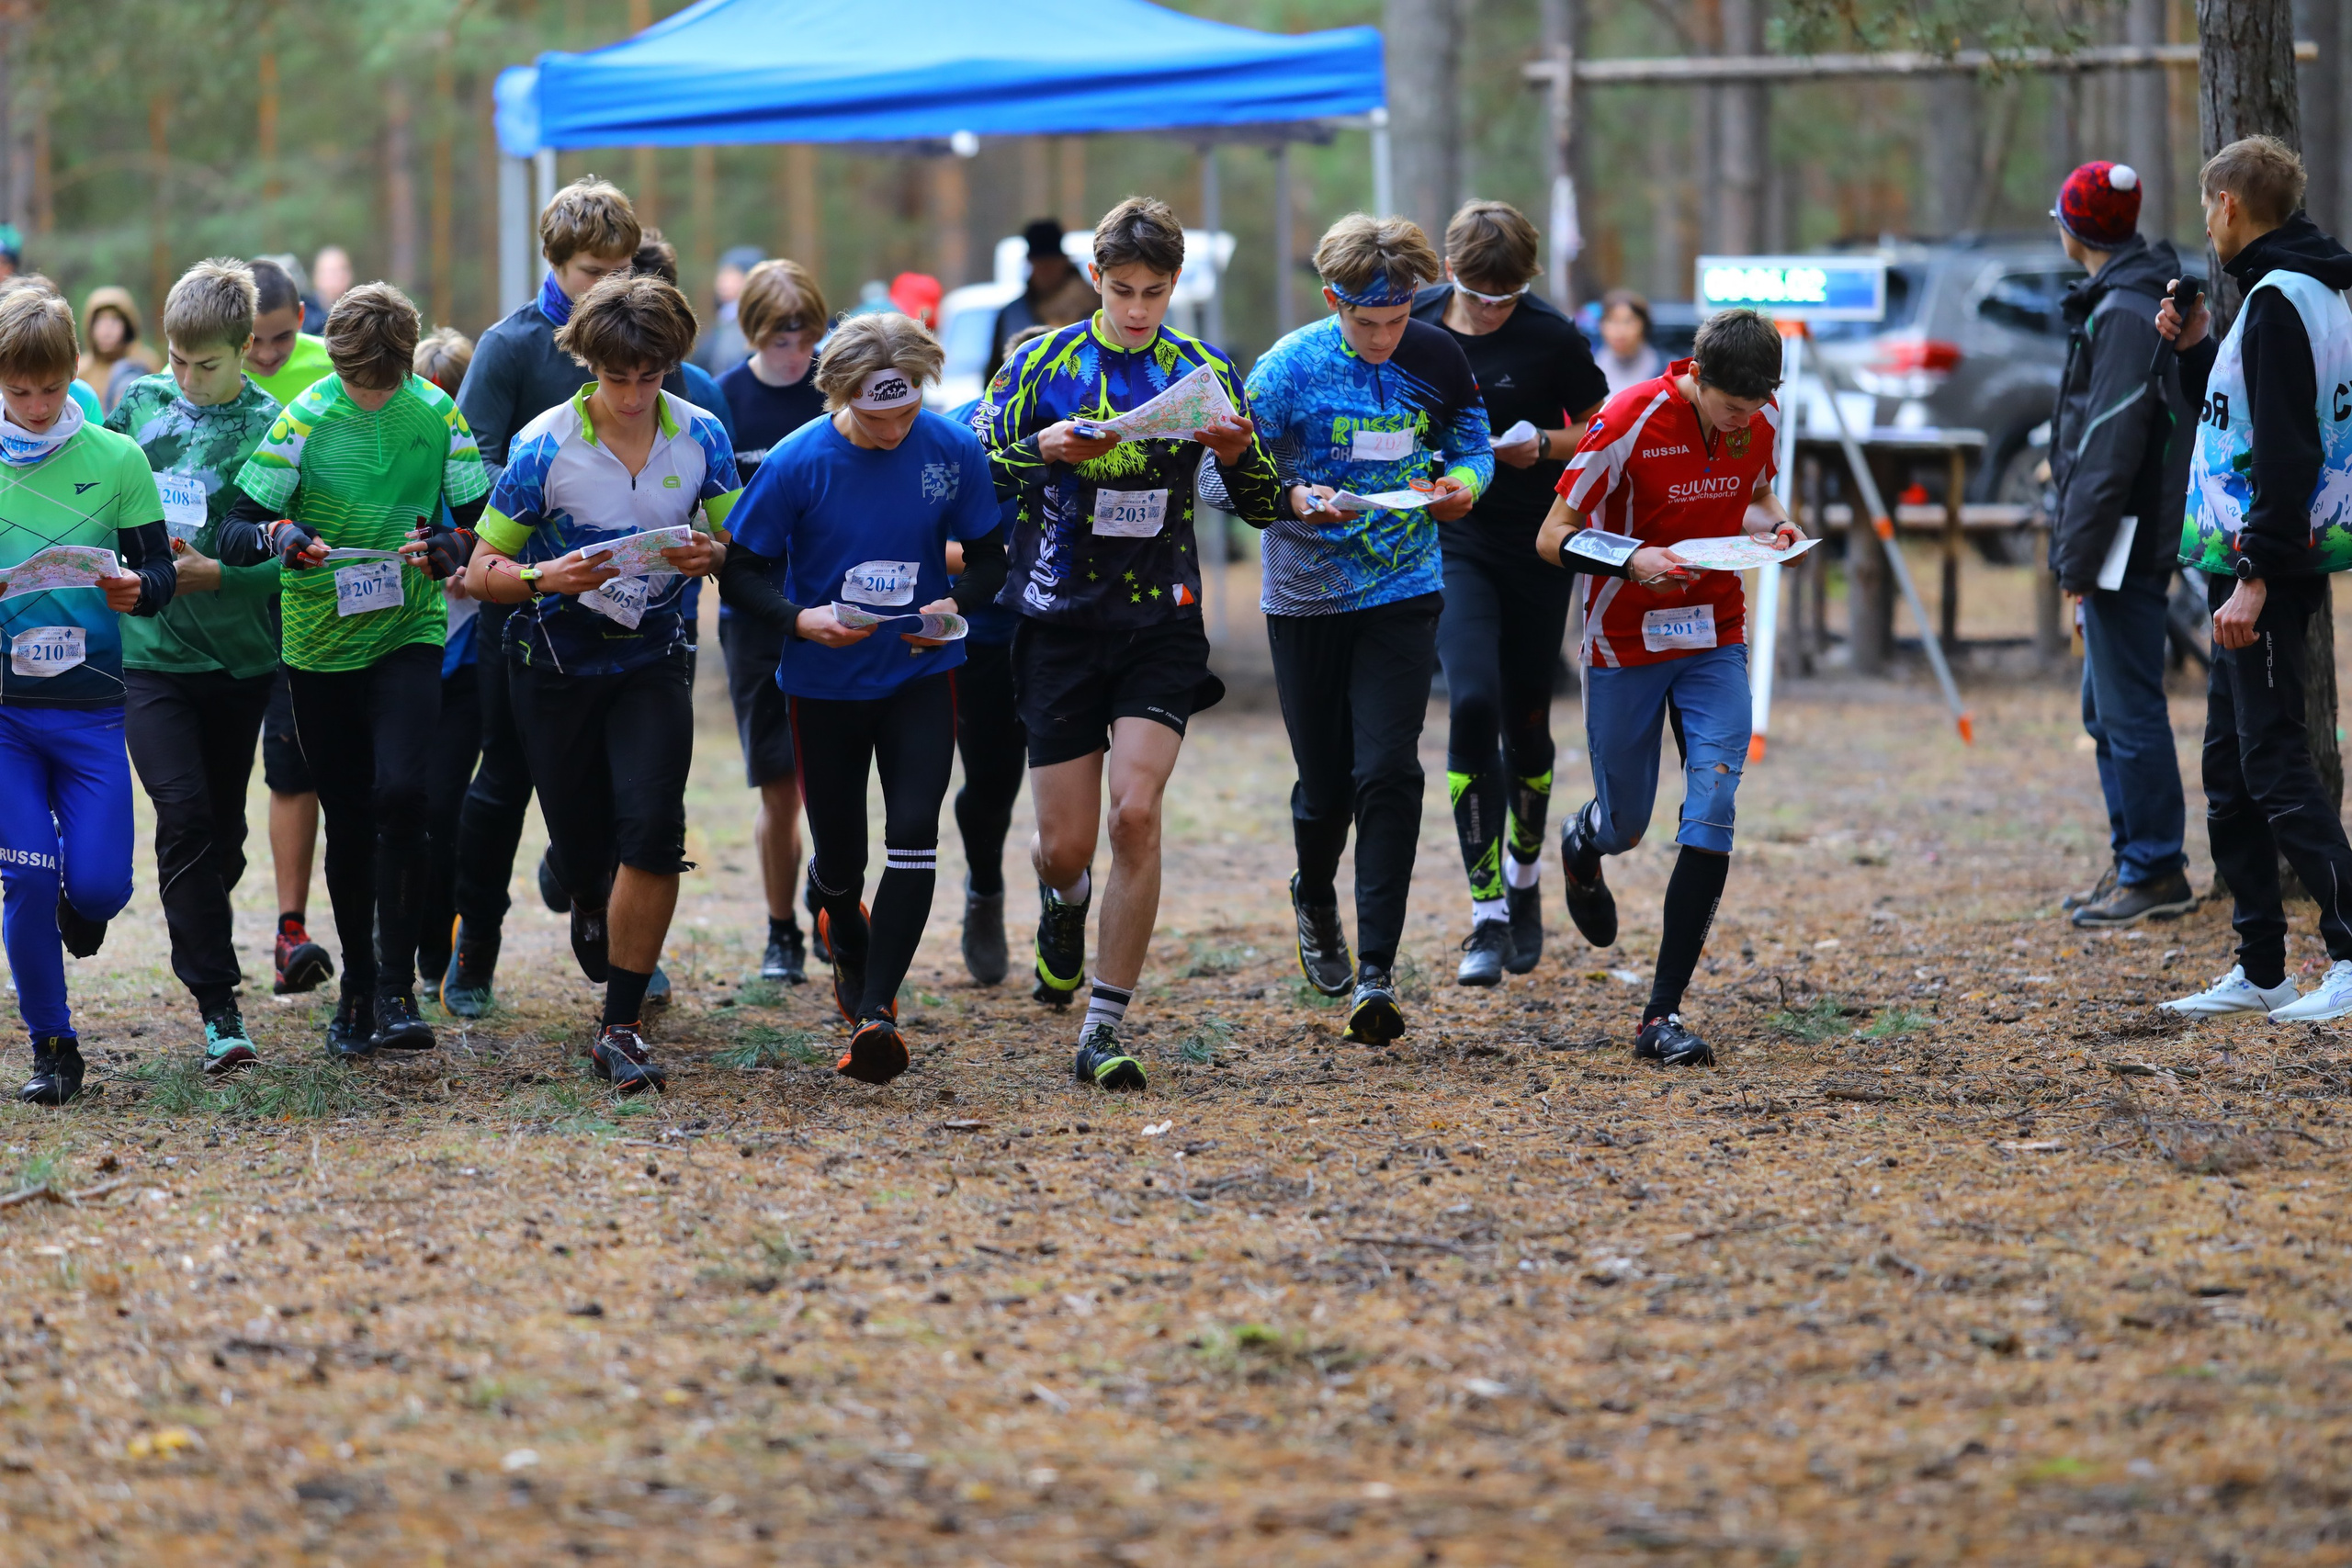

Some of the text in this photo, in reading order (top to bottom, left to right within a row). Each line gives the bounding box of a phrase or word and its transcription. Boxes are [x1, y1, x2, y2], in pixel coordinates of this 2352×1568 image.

[873, 389, 908, 402] ZAURALOM
[1642, 445, 1690, 458] RUSSIA
[1668, 476, 1740, 499] SUUNTO
[162, 488, 190, 507] 208
[1114, 506, 1147, 523] 203
[352, 578, 382, 597] 207
[865, 576, 896, 592] 204
[602, 585, 635, 609] 205
[1663, 622, 1693, 636] 201
[32, 644, 64, 660] 210
[0, 847, 56, 870] RUSSIA
